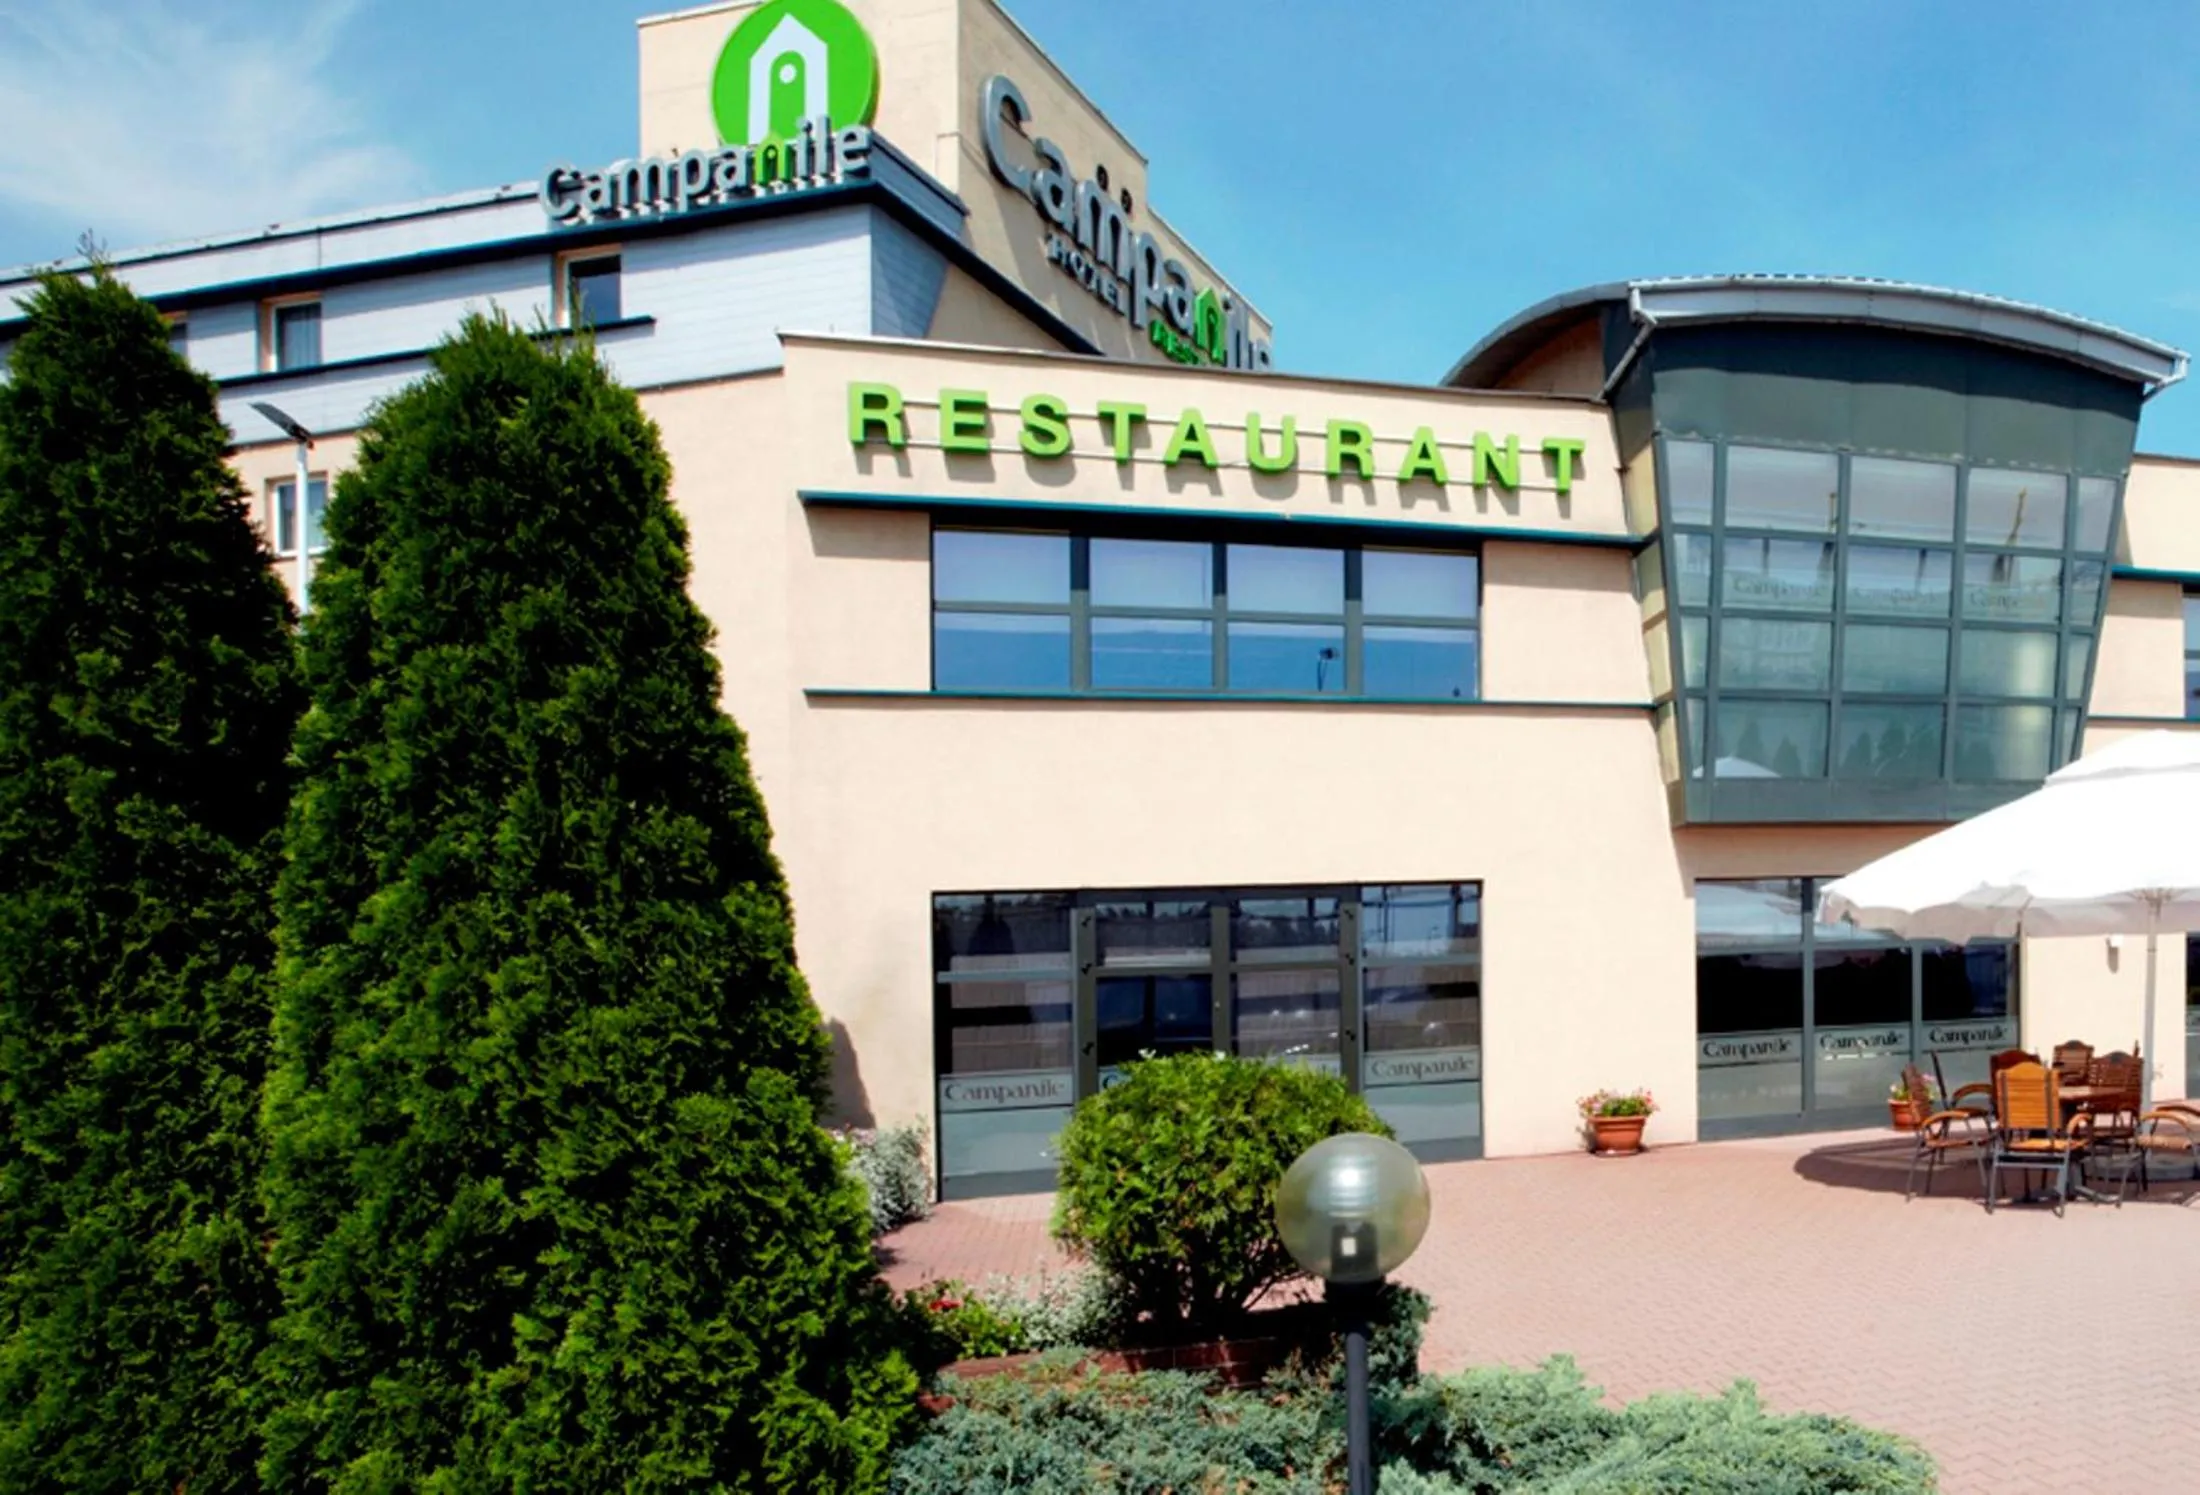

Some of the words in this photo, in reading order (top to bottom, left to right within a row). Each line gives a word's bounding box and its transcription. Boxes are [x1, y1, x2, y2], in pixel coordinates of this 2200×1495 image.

[541, 115, 871, 220] Campanile
[979, 74, 1272, 370] Campanile
[1045, 233, 1128, 316] HOTEL
[847, 381, 1585, 495] RESTAURANT
[1702, 1037, 1793, 1060] Campanile
[1930, 1024, 2008, 1045] Campanile
[944, 1078, 1066, 1104] Campanile
[1371, 1055, 1475, 1080] Campanile
